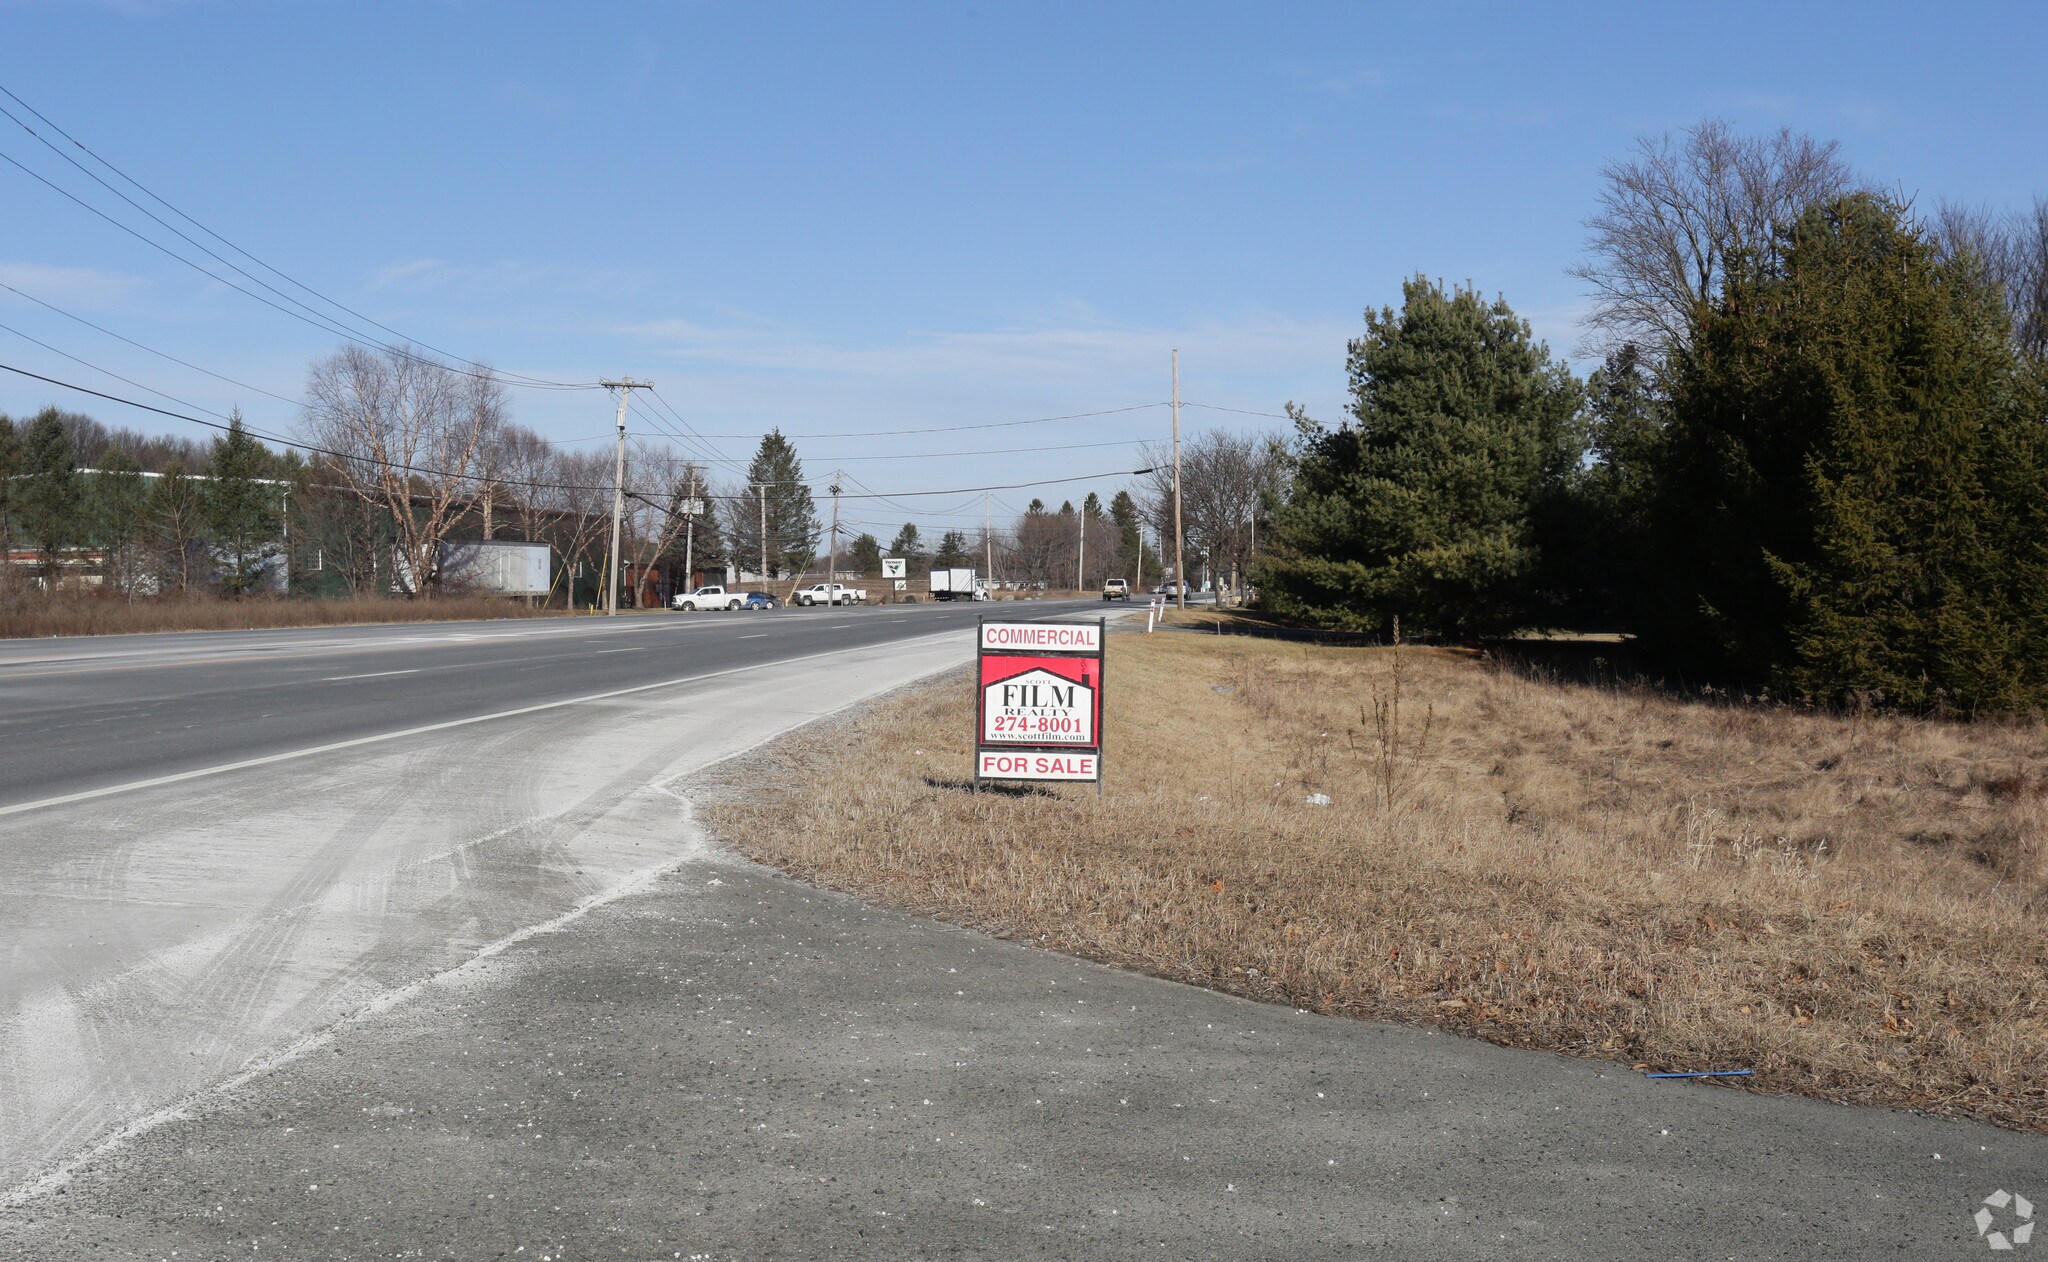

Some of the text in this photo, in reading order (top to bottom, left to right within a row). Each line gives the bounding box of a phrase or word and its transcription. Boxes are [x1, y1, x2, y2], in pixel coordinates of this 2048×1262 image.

[986, 628, 1095, 646] COMMERCIAL
[1001, 684, 1076, 708] FILM
[1004, 708, 1072, 717] REALTY
[994, 716, 1082, 733] 274-8001
[990, 732, 1085, 741] www.scottfilm.com
[983, 757, 1093, 774] FOR SALE
